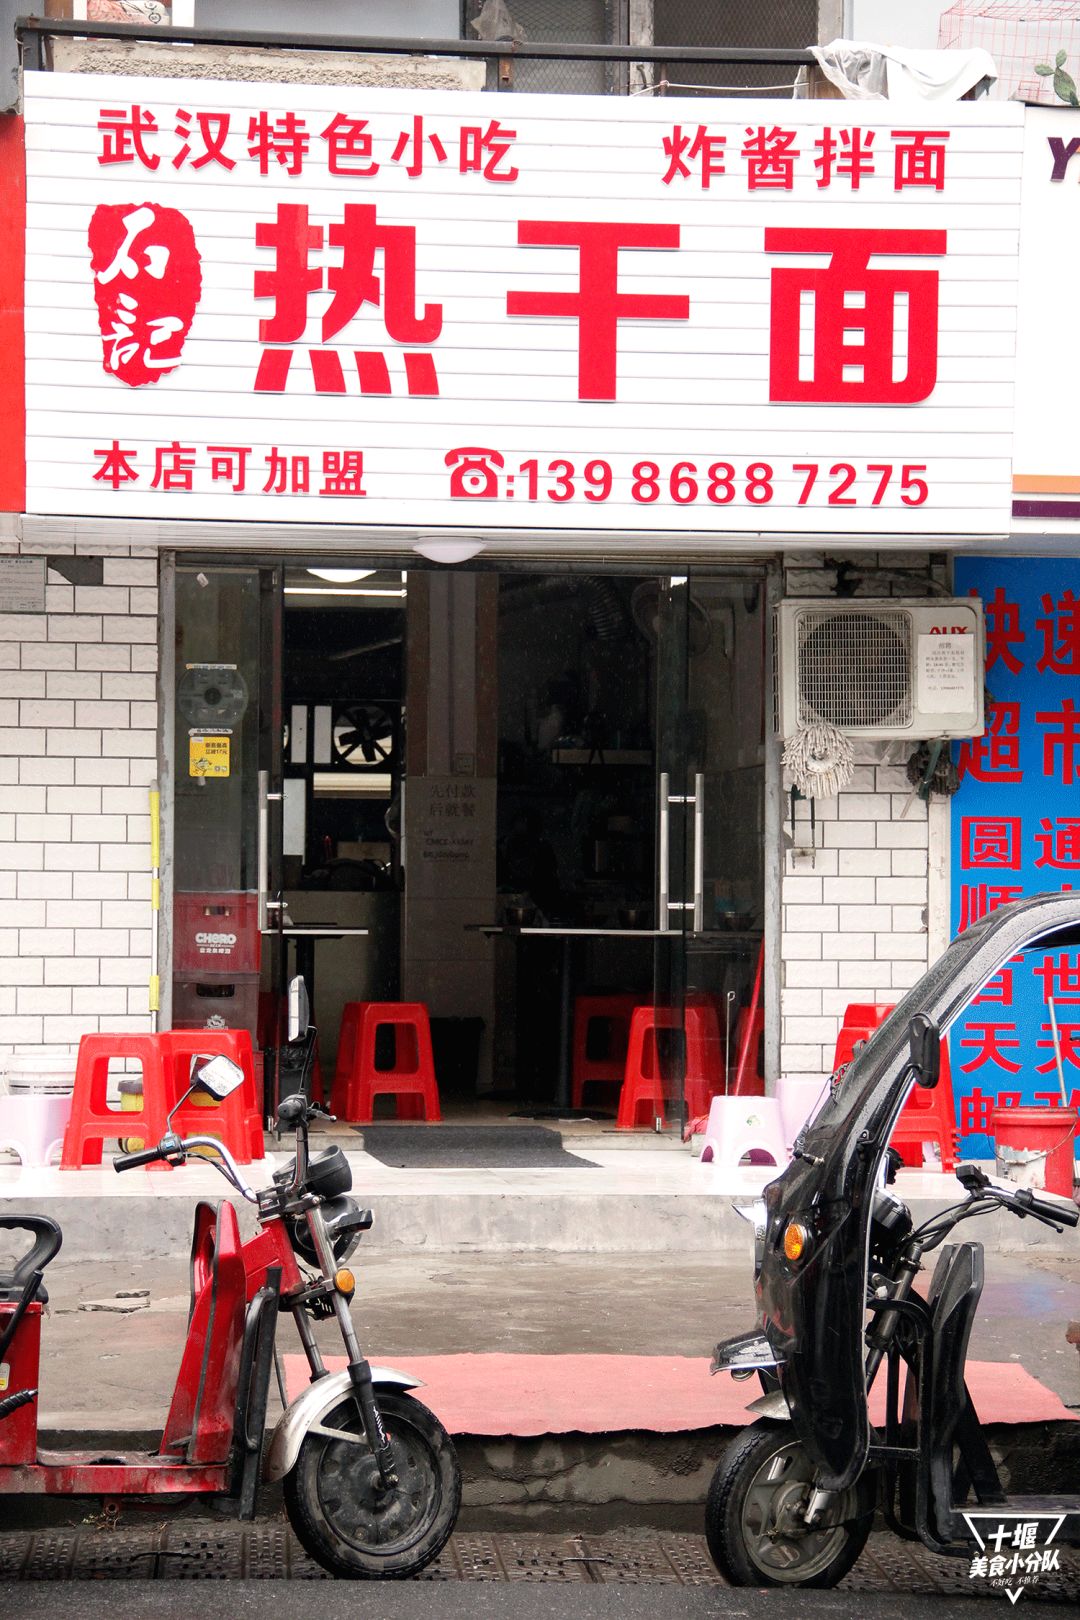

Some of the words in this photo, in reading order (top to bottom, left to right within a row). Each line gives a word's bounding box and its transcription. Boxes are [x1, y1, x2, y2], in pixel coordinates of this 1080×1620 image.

[97, 105, 520, 183] 武汉特色小吃
[661, 124, 951, 192] 炸酱拌面
[254, 203, 948, 405] 热干面
[92, 440, 367, 497] 本店可加盟
[630, 461, 774, 505] 8688
[792, 463, 929, 507] 7275
[961, 816, 1080, 871] 圆通
